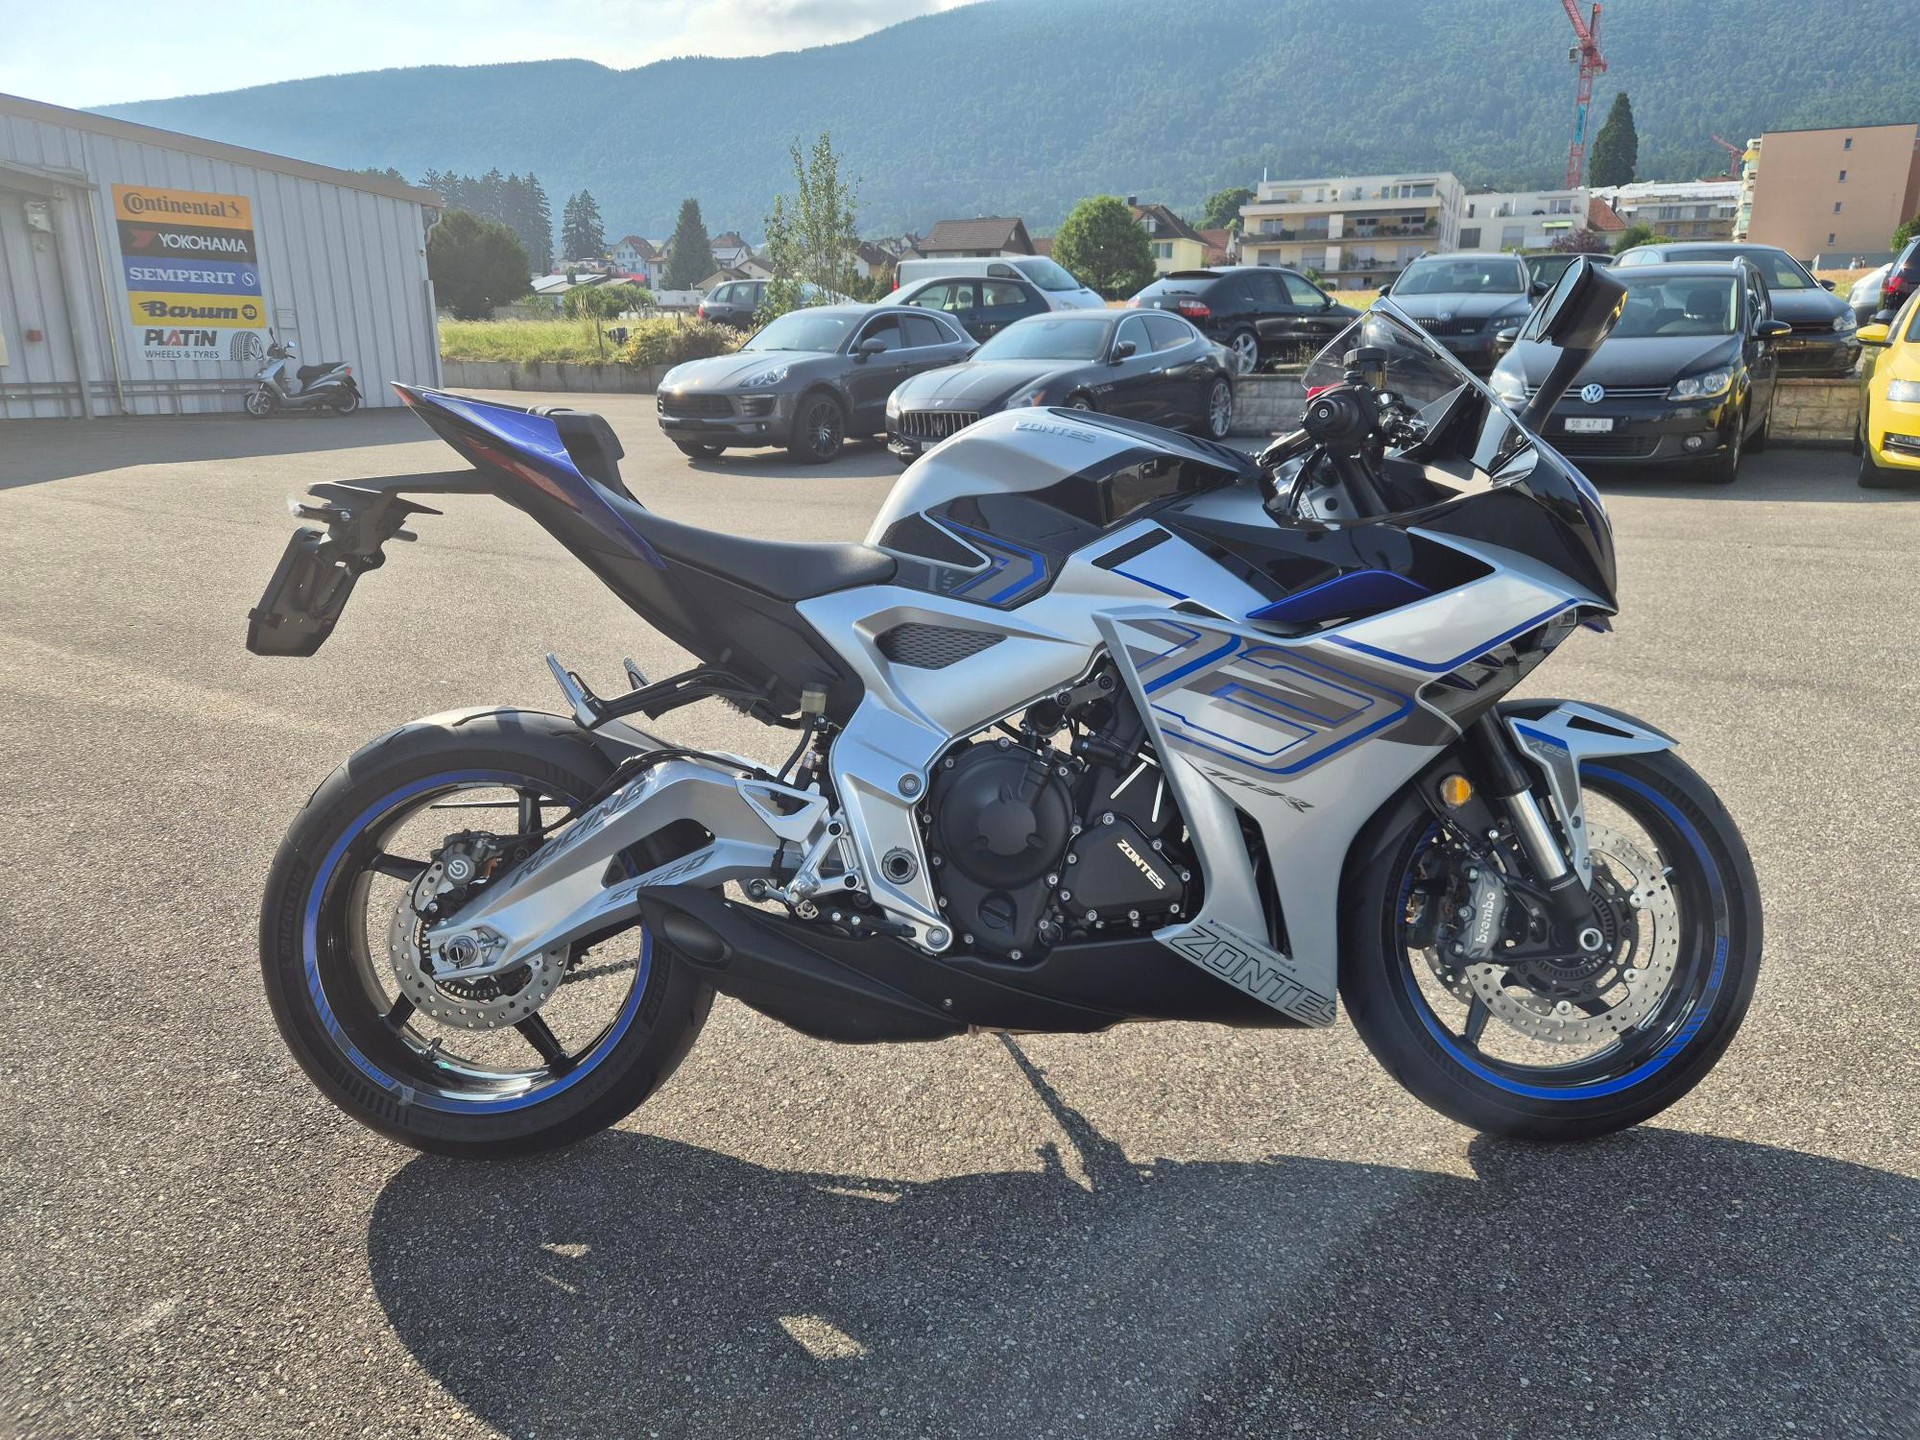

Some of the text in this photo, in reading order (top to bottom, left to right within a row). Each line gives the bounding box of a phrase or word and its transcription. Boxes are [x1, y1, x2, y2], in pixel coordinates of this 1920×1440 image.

[123, 192, 226, 217] Continental
[158, 233, 248, 253] YOKOHAMA
[129, 267, 236, 285] SEMPERIT
[140, 301, 238, 319] Barum
[145, 350, 182, 359] WHEELS
[193, 350, 220, 359] TYRES
[1012, 421, 1097, 443] ZONTES
[509, 777, 650, 889] RACING
[1117, 839, 1166, 890] ZONTES
[1475, 892, 1496, 944] brembo
[1170, 925, 1337, 1024] ZONTES
